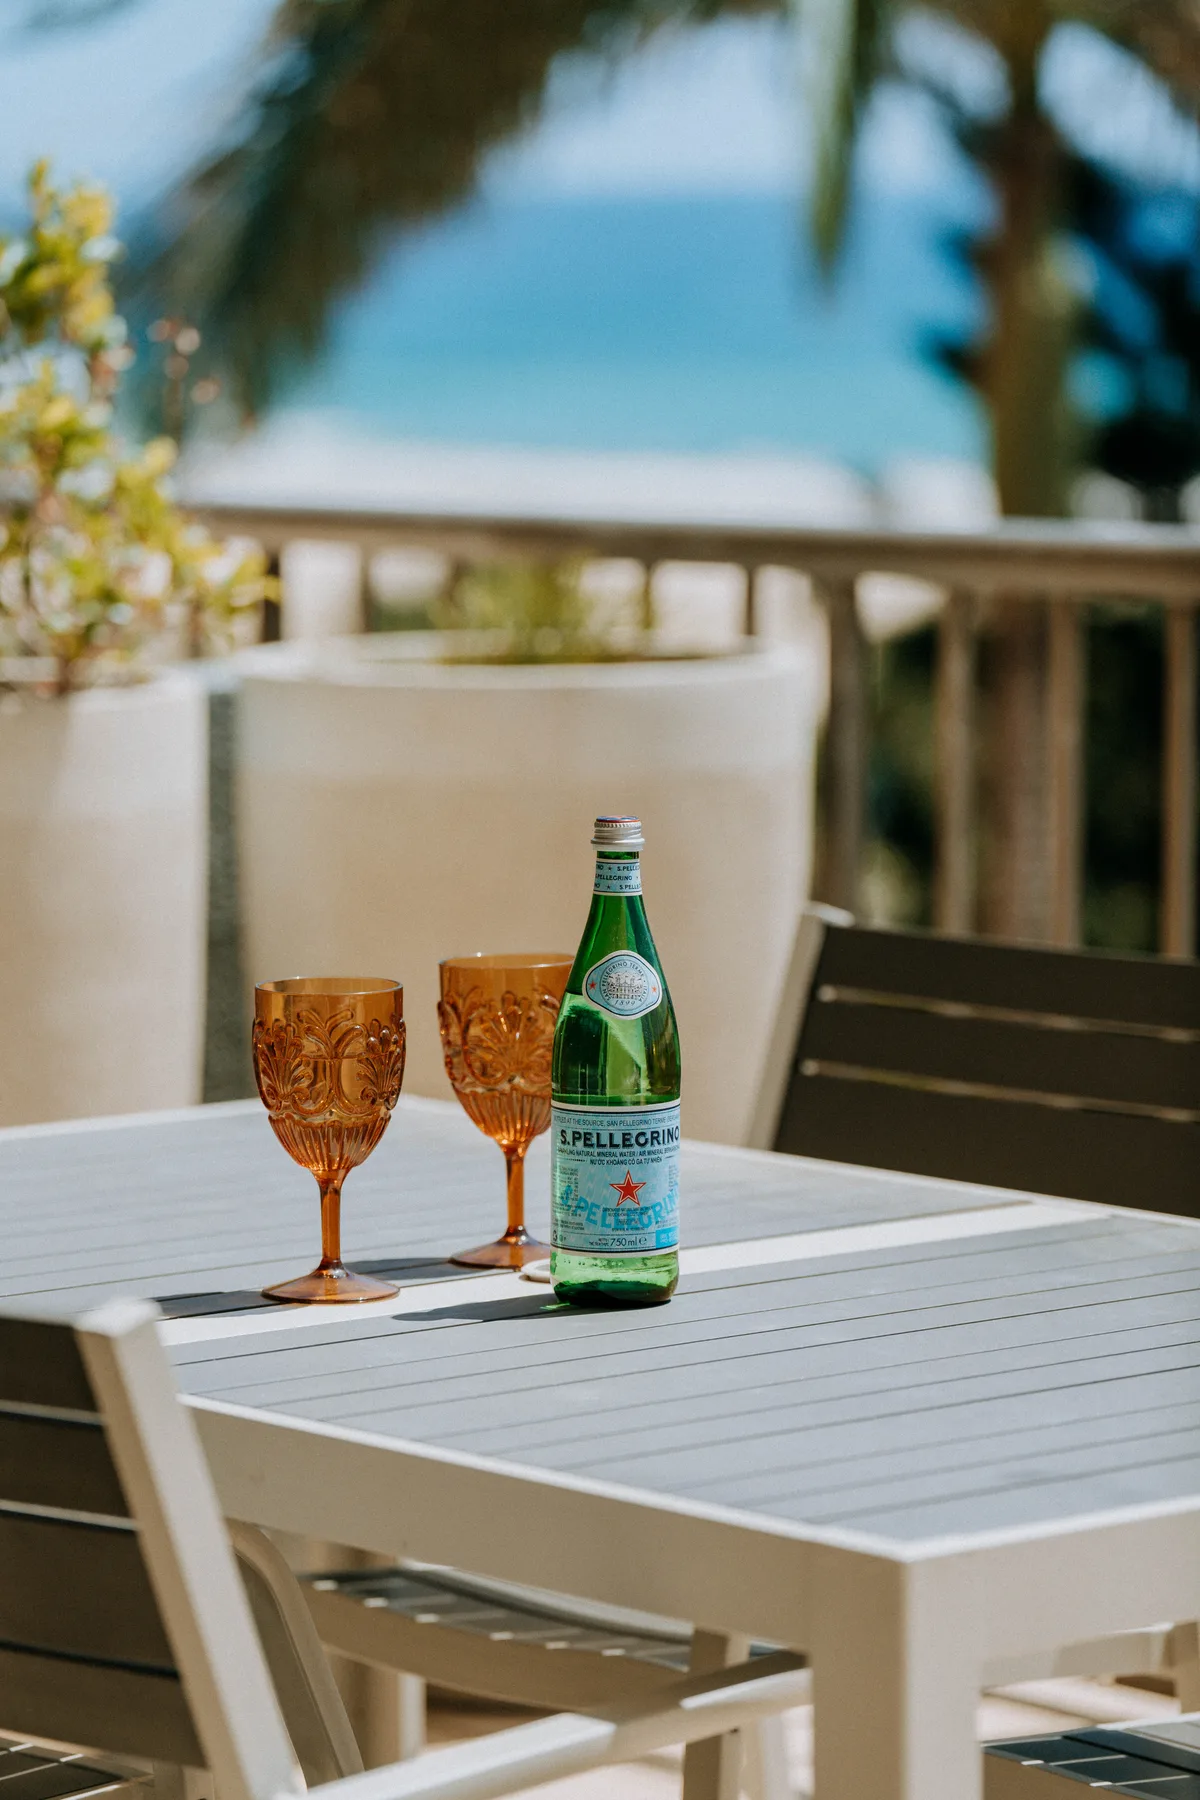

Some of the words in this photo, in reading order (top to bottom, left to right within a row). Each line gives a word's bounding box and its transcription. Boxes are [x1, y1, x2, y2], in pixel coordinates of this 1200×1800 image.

[602, 961, 628, 986] PELLEGRINO
[573, 1118, 581, 1126] THE
[582, 1119, 605, 1127] SOURCE,
[606, 1119, 618, 1127] SAN
[619, 1118, 652, 1127] PELLEGRINO
[560, 1125, 680, 1149] S.PELLEGRINO
[576, 1149, 596, 1157] NATURAL
[611, 1237, 627, 1247] 750
